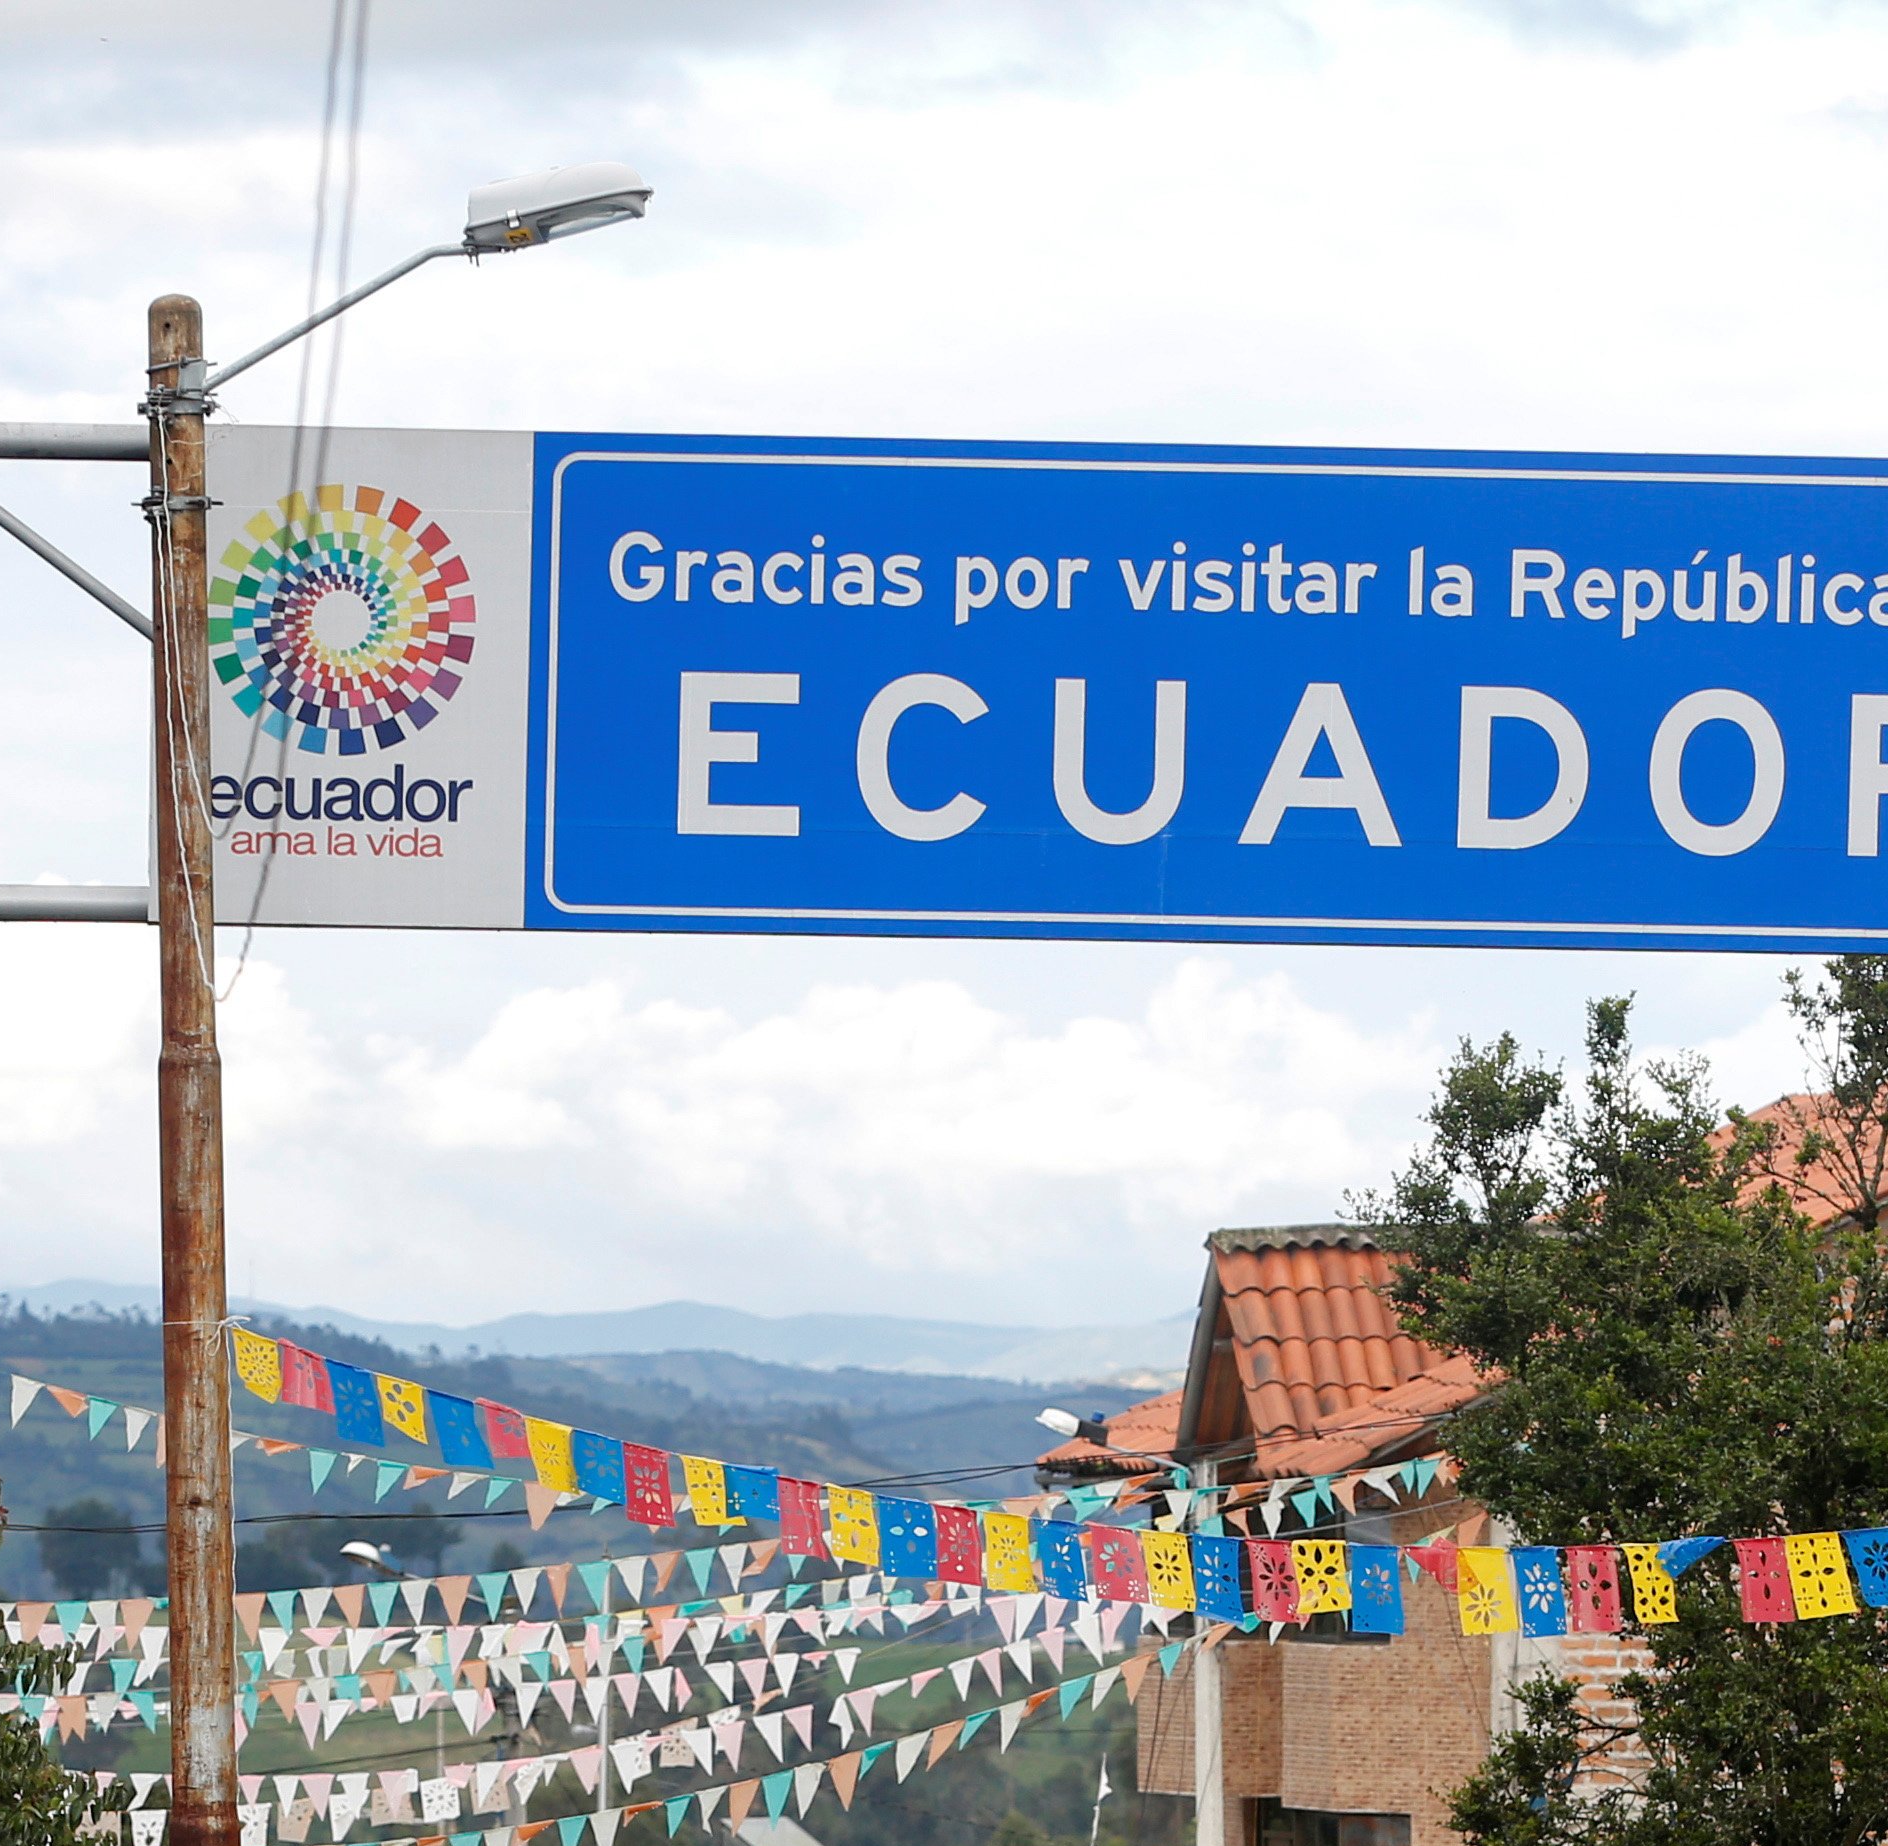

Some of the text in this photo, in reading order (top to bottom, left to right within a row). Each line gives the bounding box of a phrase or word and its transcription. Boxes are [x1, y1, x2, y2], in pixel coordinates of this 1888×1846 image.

[610, 531, 924, 607] Gracias
[955, 555, 1091, 625] por
[1119, 541, 1377, 615] visitar
[1409, 546, 1474, 617] la
[211, 763, 473, 822] ecuador
[230, 825, 444, 857] ama la vida
